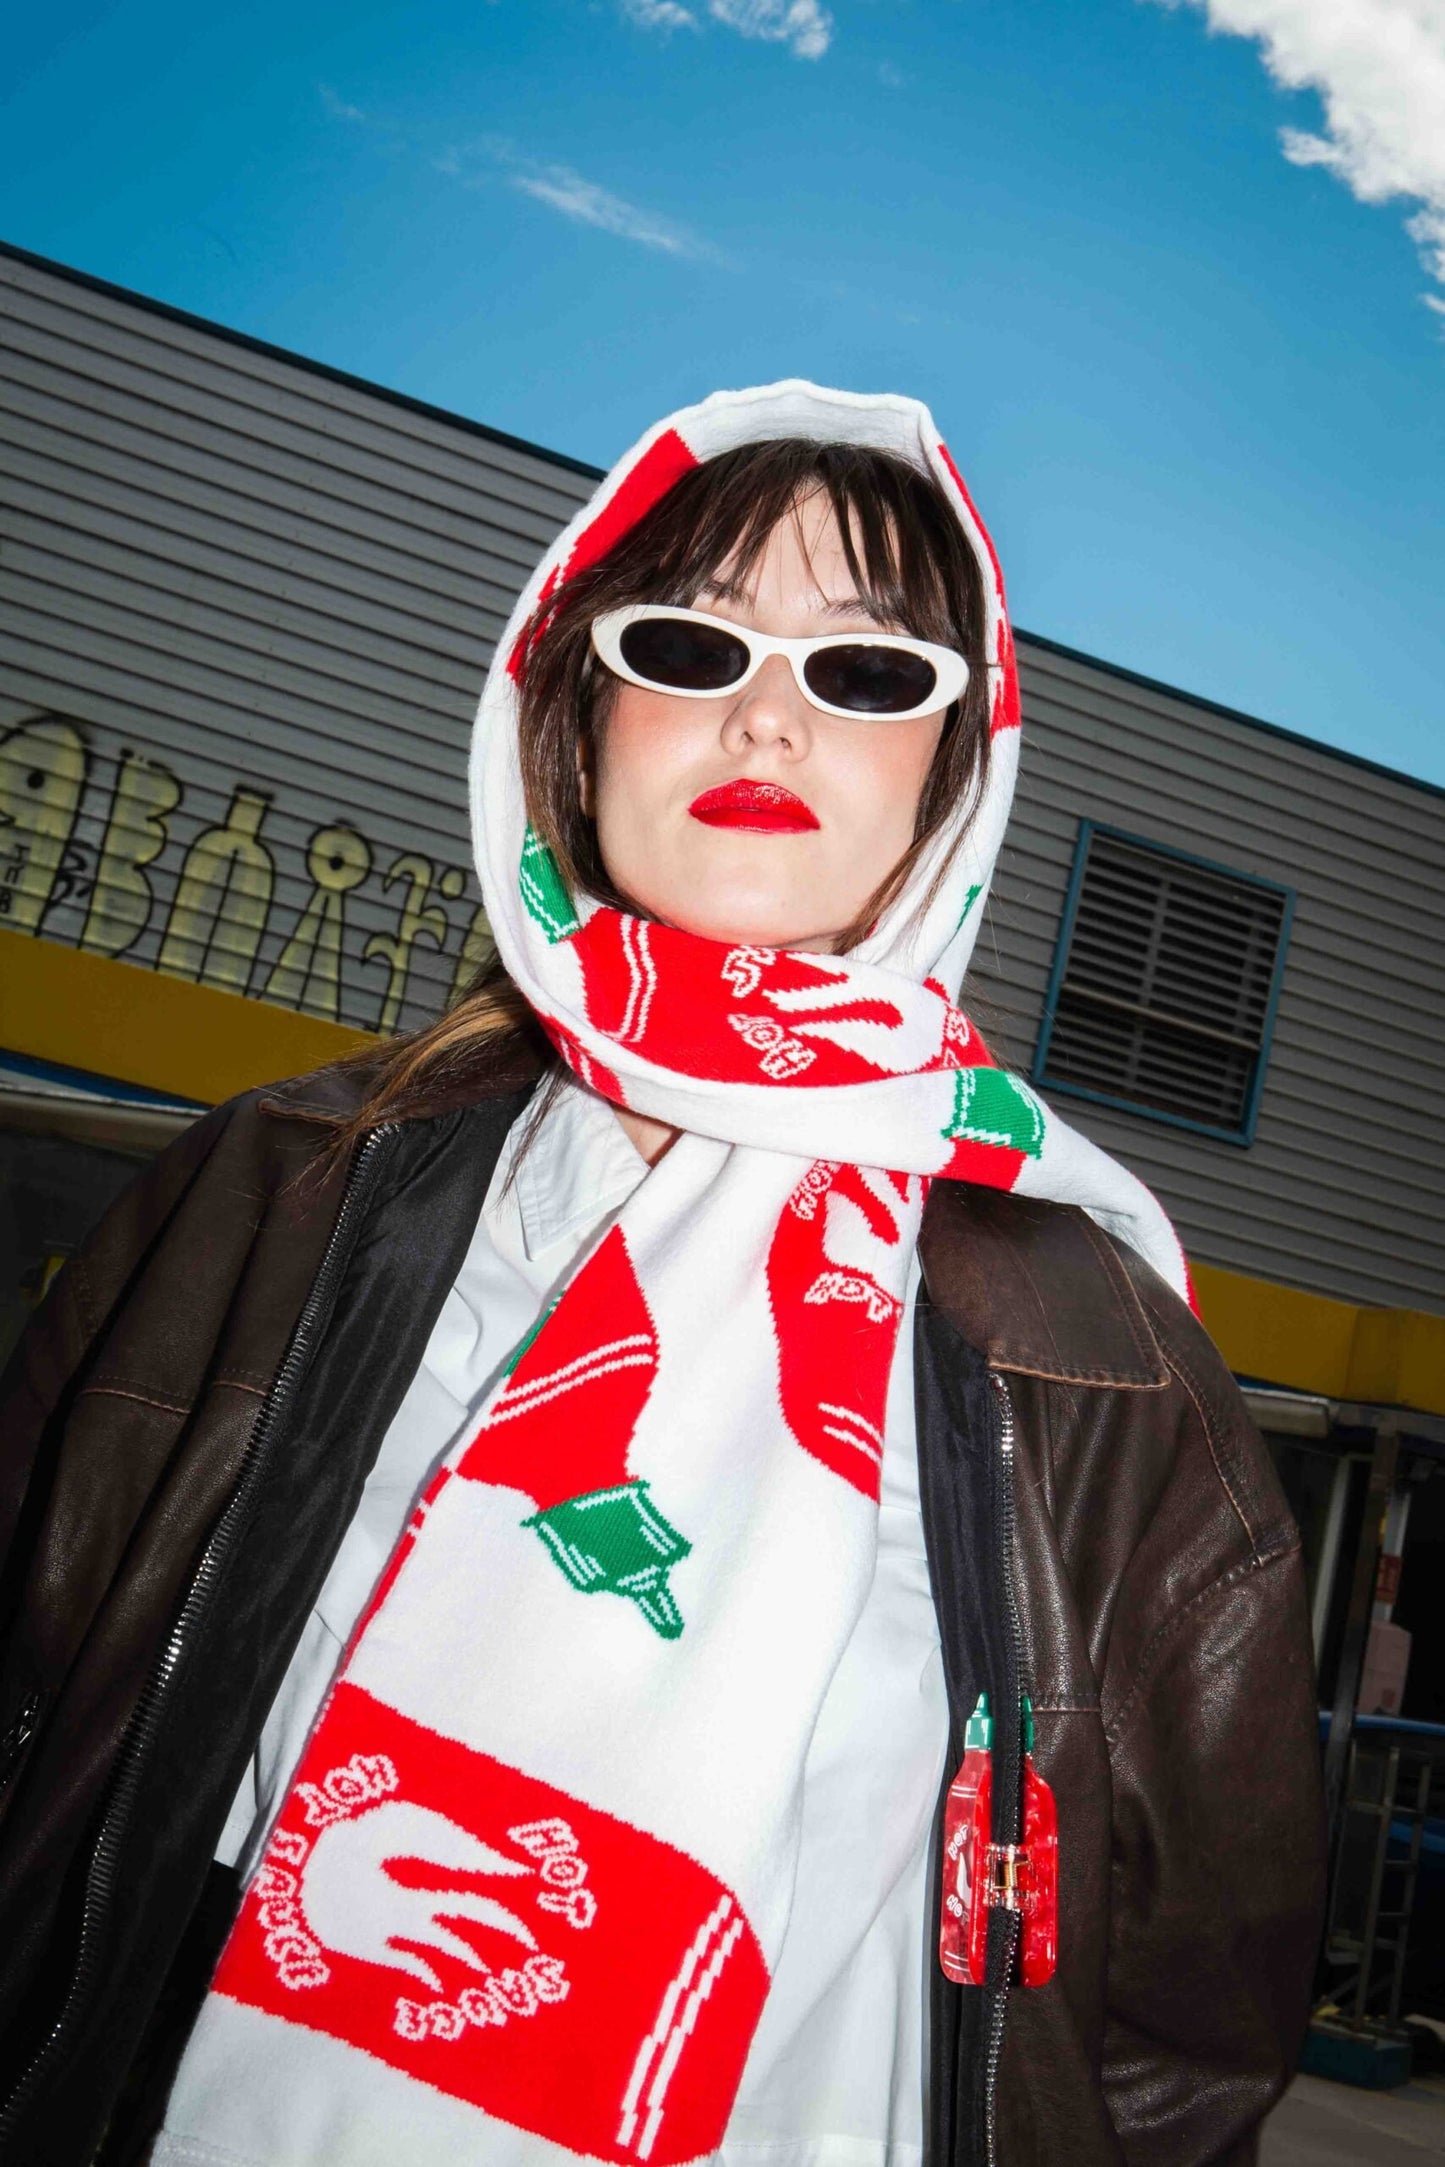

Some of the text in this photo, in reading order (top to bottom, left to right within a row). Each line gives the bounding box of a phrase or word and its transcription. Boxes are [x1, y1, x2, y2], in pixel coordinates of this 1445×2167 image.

[727, 1013, 818, 1080] HOT
[803, 1271, 894, 1324] HOT
[253, 1753, 399, 1991] HOT SAUCE
[947, 1823, 969, 1861] HOT
[393, 1817, 597, 2042] HOT SAUCE
[946, 1893, 970, 1926] HOT
